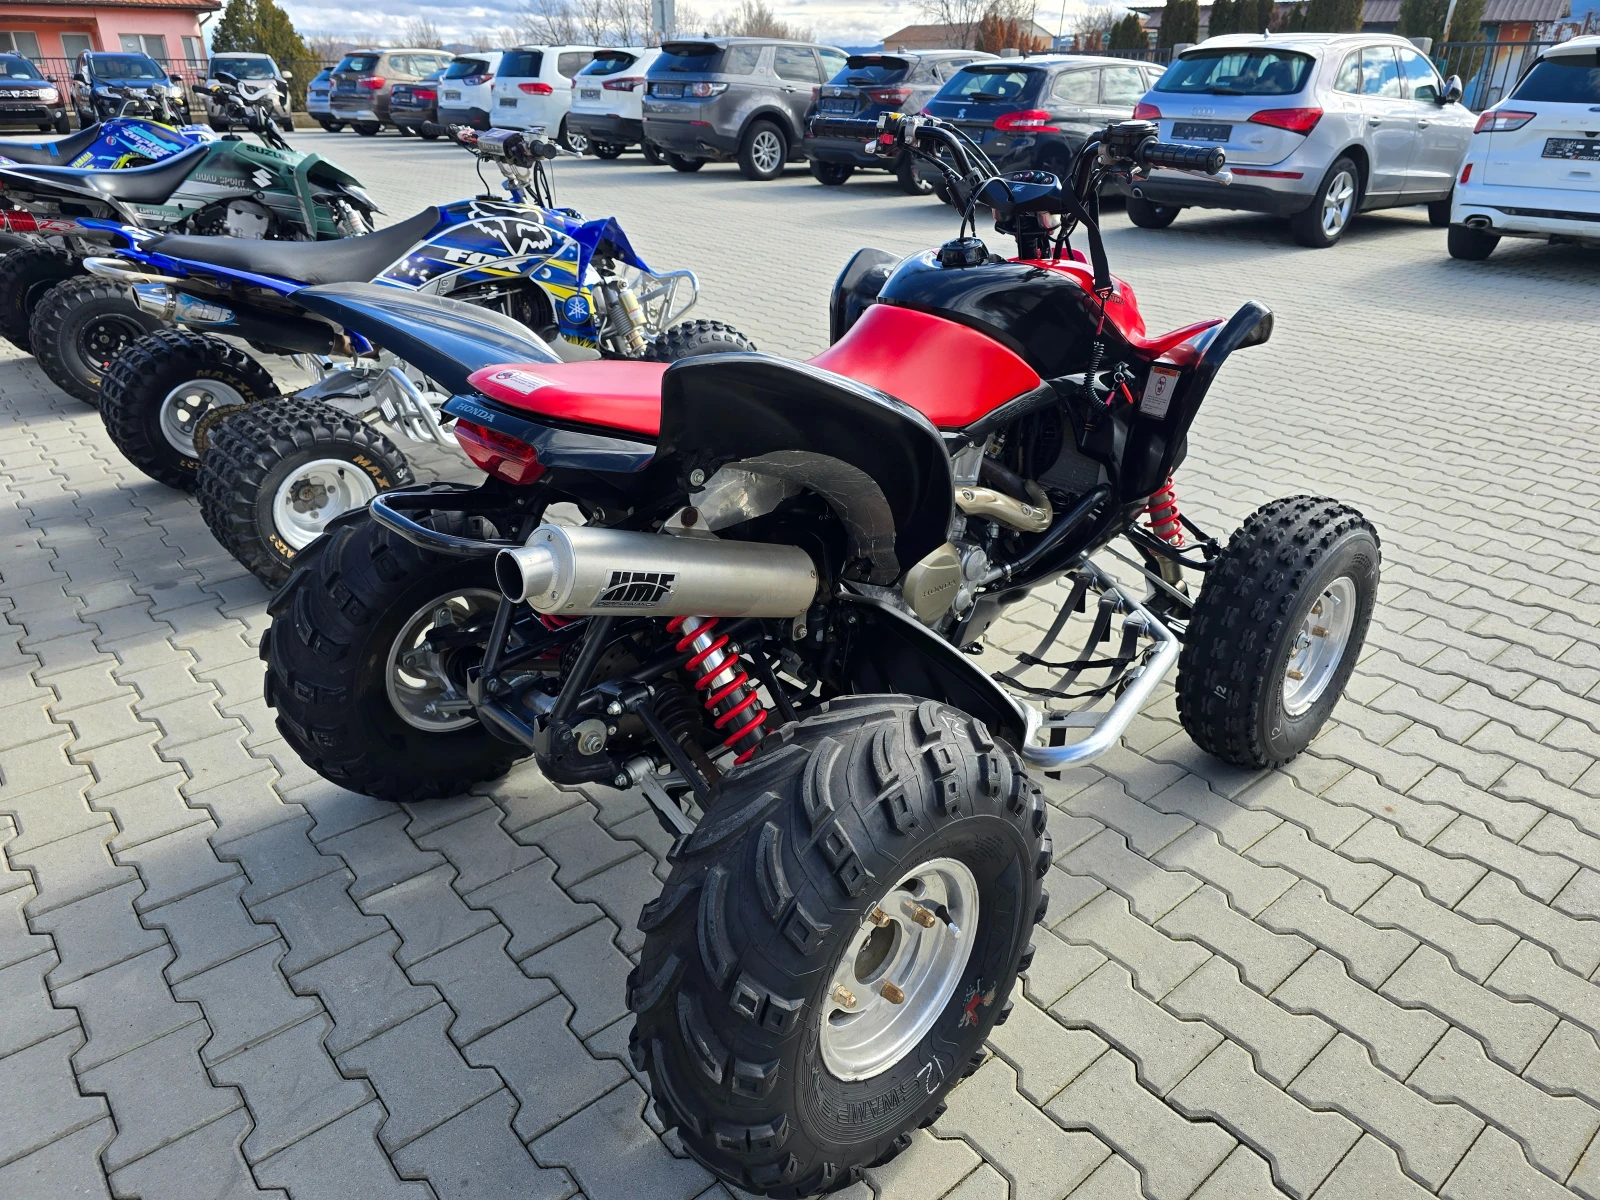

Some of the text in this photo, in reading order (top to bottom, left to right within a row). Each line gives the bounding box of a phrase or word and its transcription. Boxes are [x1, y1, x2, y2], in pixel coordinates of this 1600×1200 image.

[71, 151, 94, 169] YAMAHA
[444, 249, 525, 274] FOX
[456, 402, 497, 423] HONDA
[352, 454, 391, 488] MAX
[601, 571, 675, 602] HMF
[921, 579, 957, 599] HONDA
[1213, 684, 1227, 700] 12
[1271, 719, 1283, 741] 12
[916, 1054, 945, 1095] 12
